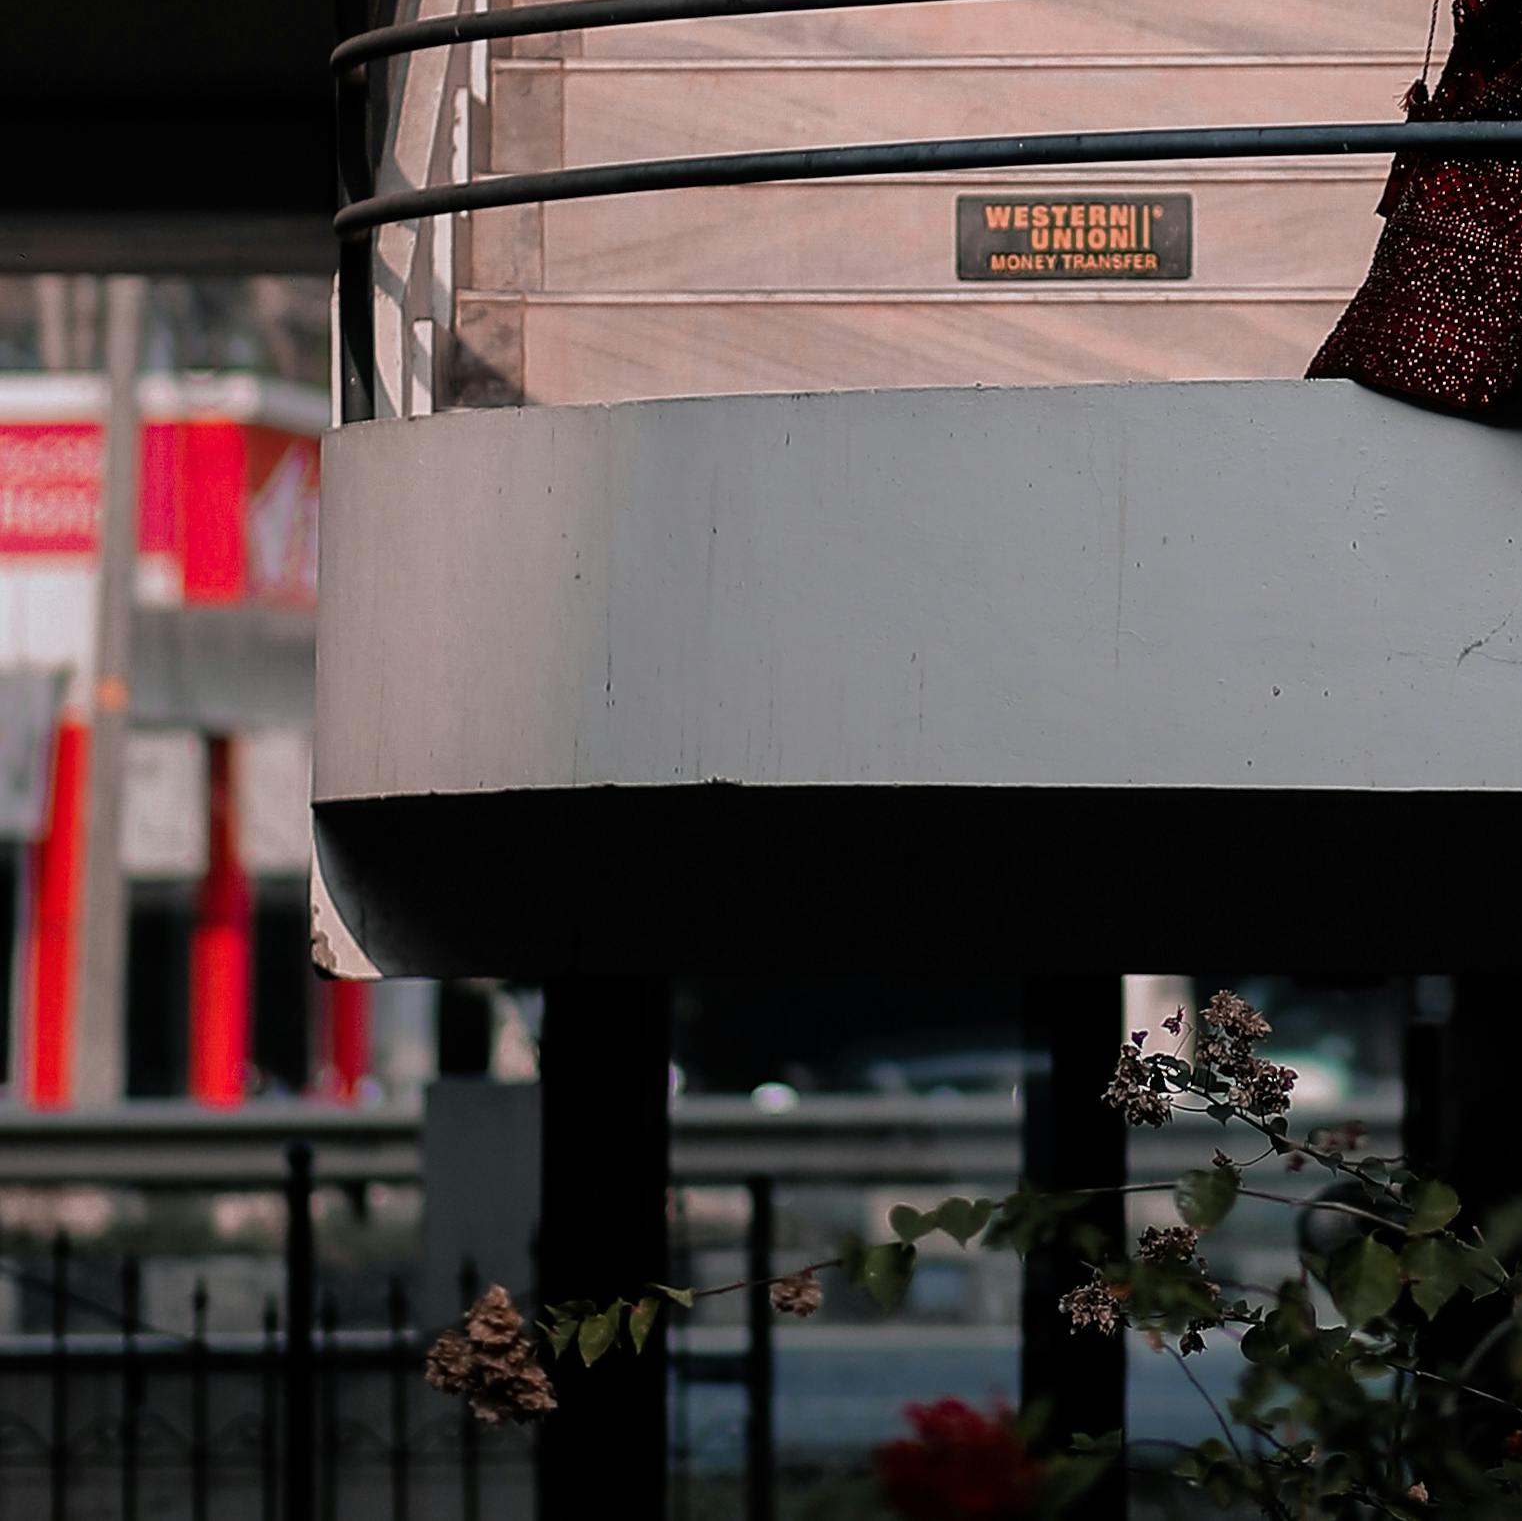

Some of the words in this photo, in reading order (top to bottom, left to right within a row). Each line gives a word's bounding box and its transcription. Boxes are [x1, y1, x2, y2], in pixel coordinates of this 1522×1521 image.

[986, 205, 1128, 228] WESTERN
[1031, 228, 1128, 249] UNION
[991, 254, 1057, 270] MONEY
[1061, 254, 1157, 270] TRANSFER
